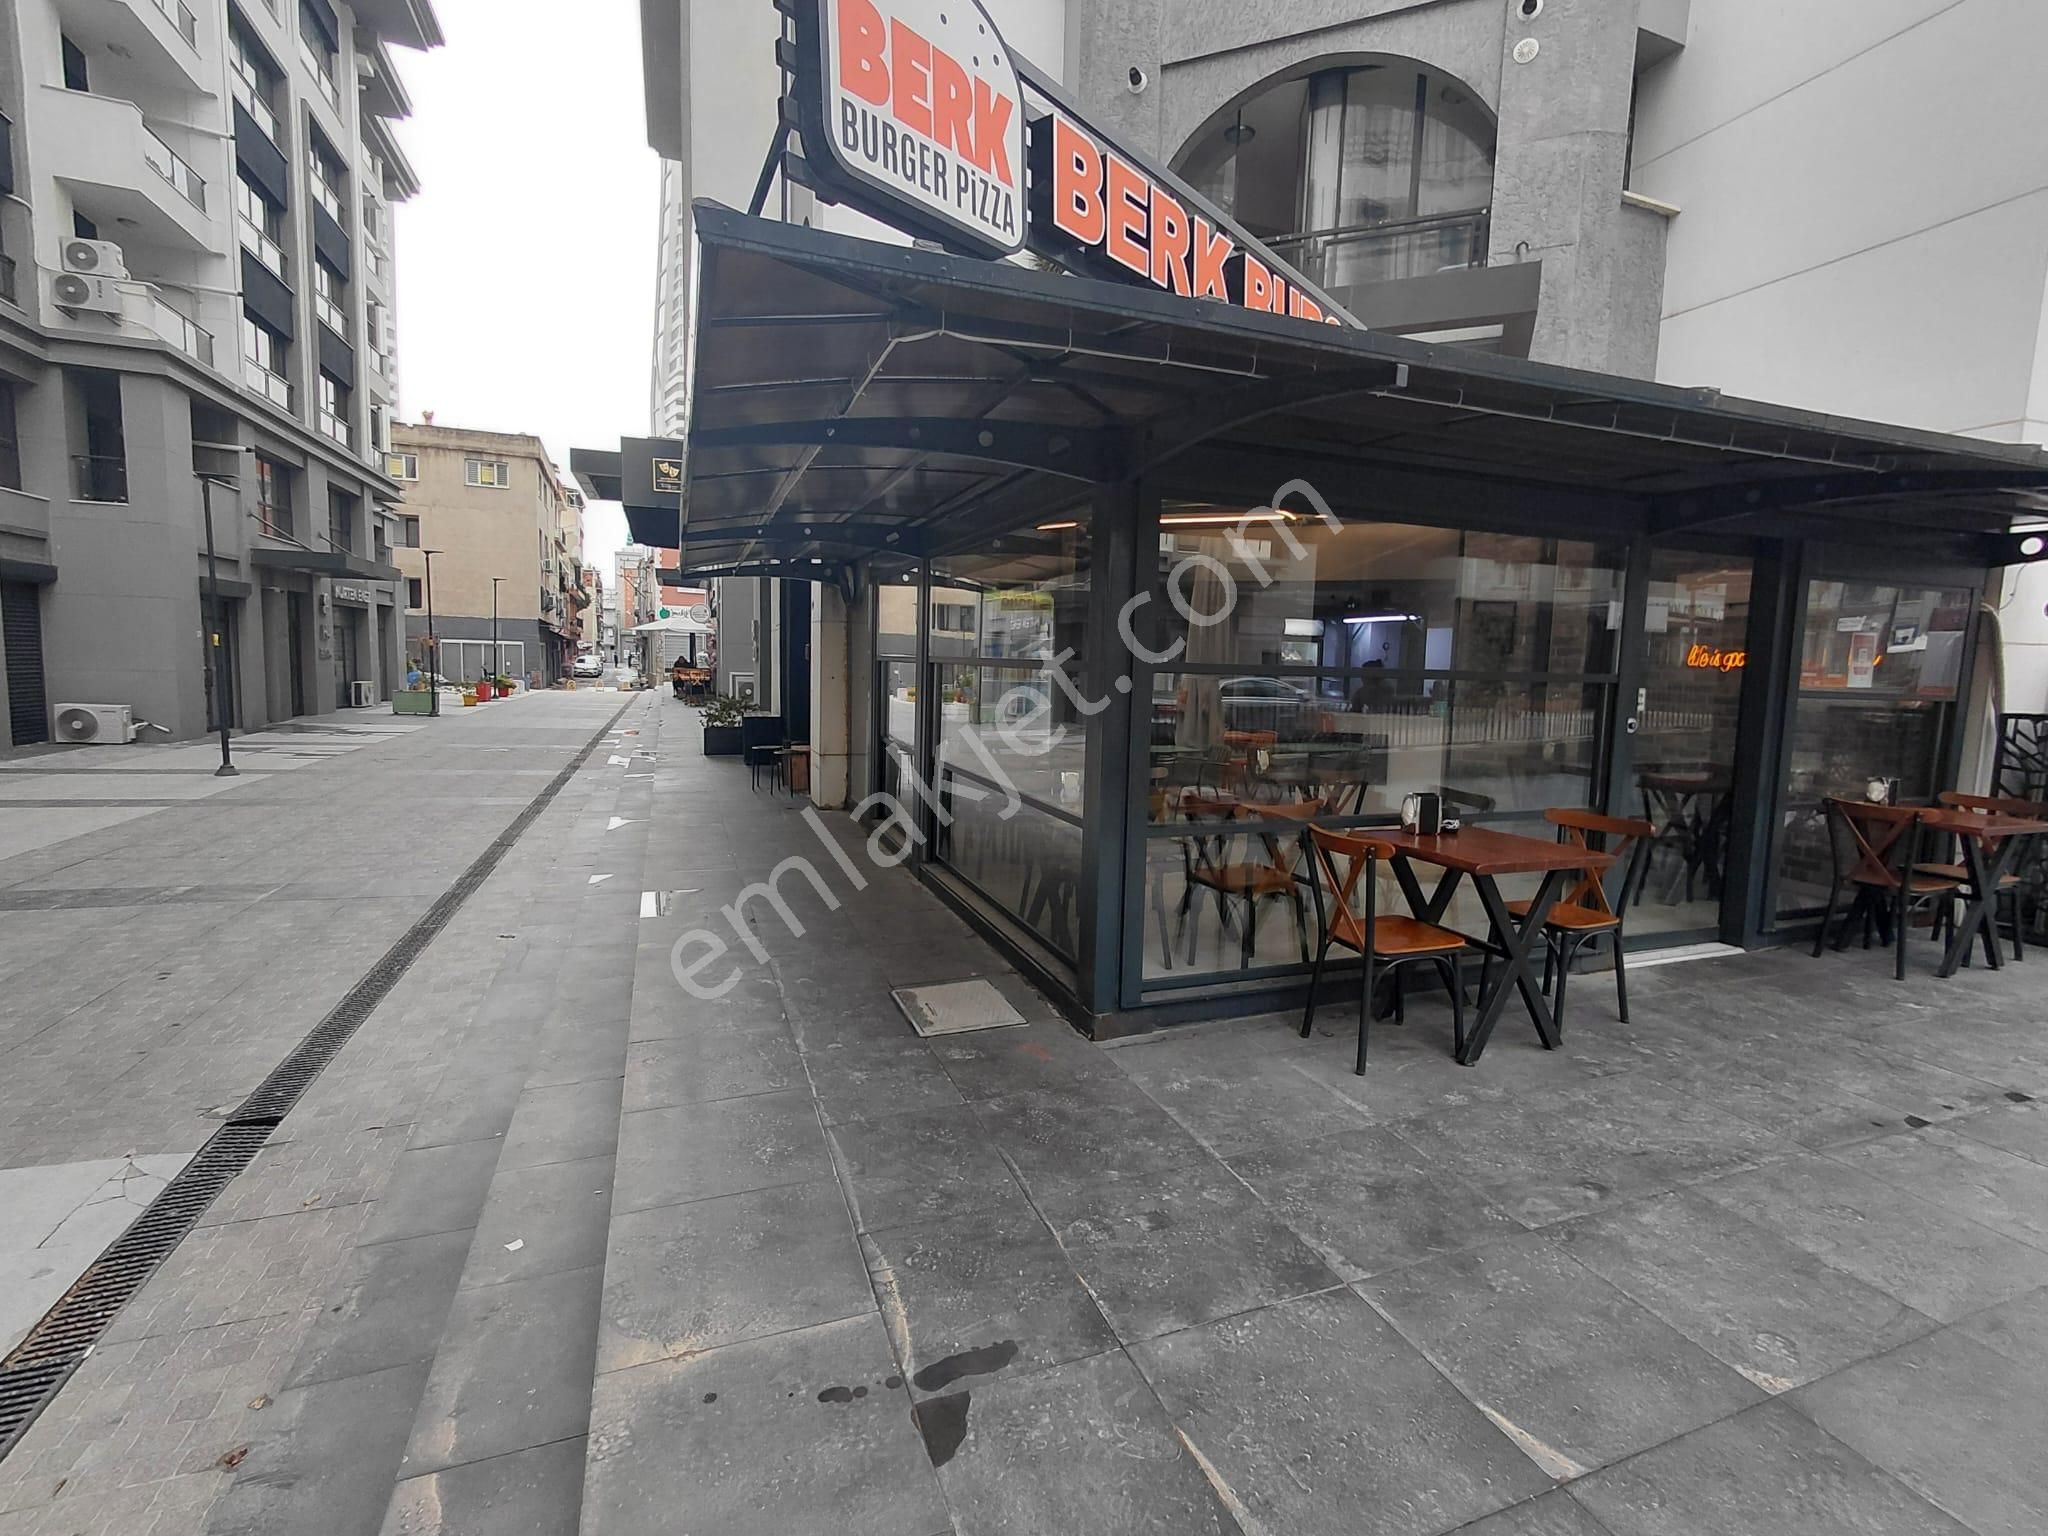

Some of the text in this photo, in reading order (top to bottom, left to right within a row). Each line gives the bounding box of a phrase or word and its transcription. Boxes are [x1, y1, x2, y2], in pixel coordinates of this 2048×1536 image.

[836, 0, 1014, 189] BERK
[840, 96, 949, 201] BURGER
[1053, 112, 1235, 304] BERK
